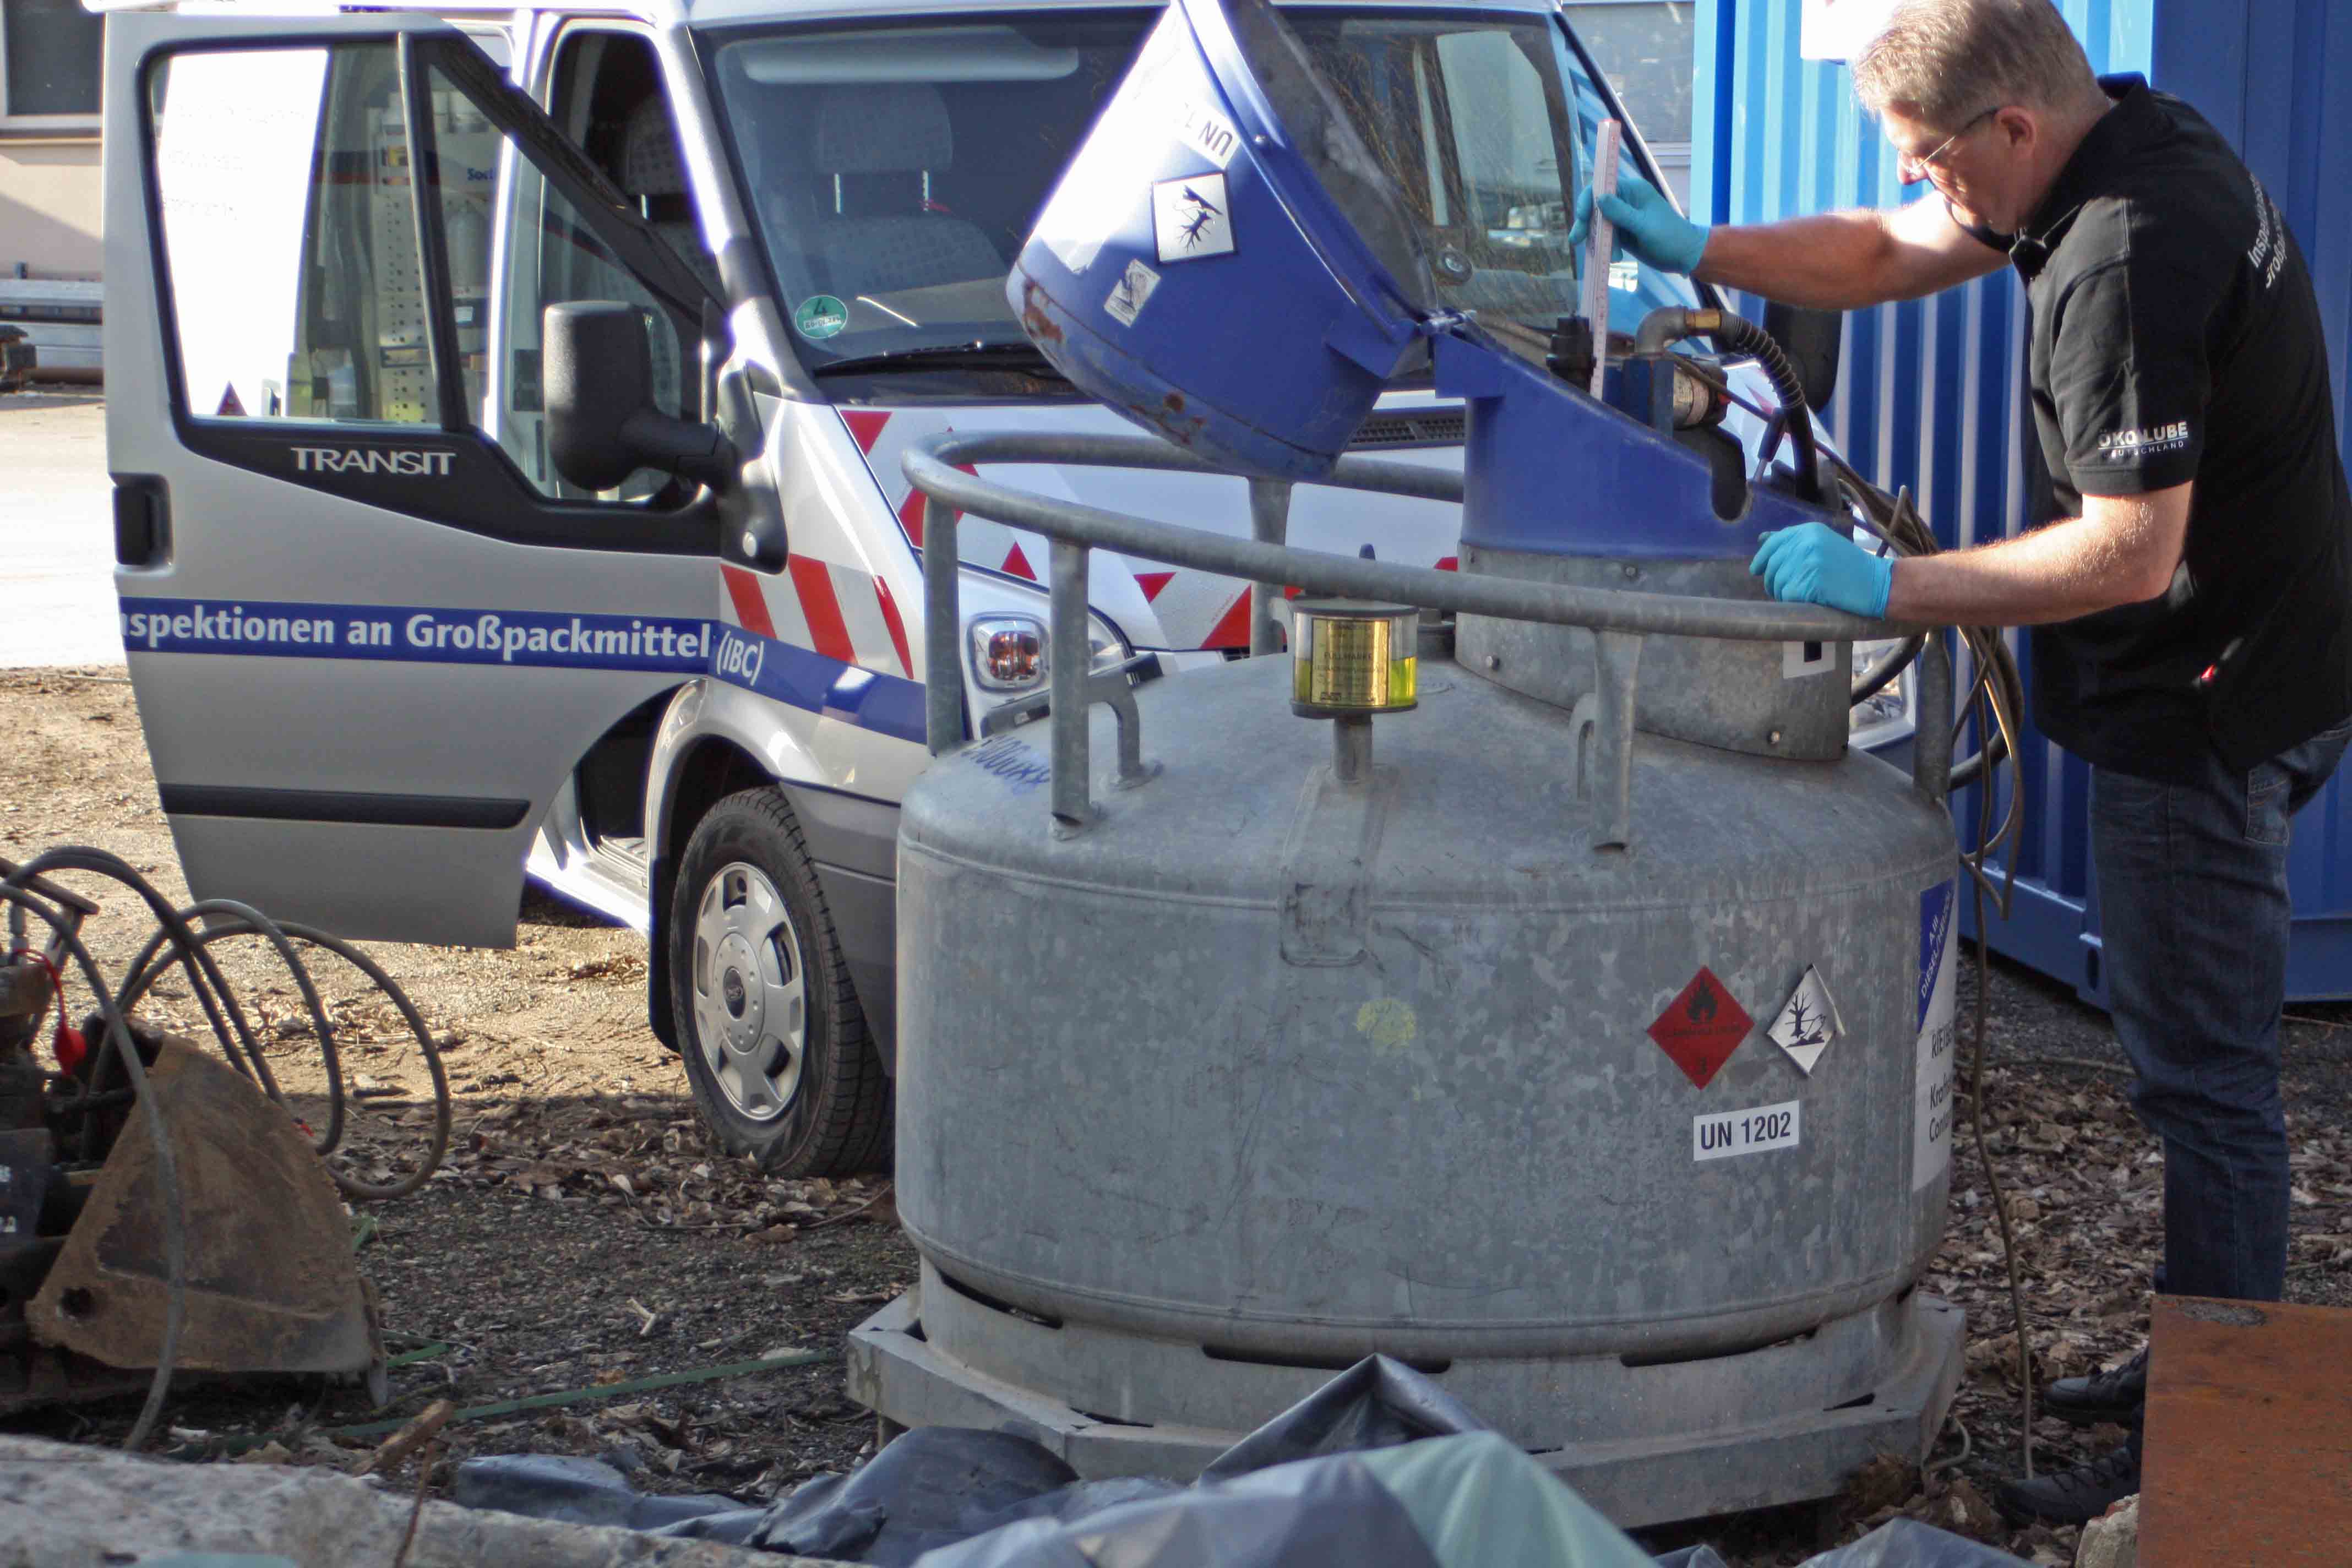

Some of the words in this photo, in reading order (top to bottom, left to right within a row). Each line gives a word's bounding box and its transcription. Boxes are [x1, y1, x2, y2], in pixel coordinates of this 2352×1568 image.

[291, 447, 456, 475] TRANSIT
[347, 620, 392, 645] an
[406, 614, 711, 661] Großpackmittel
[716, 630, 765, 686] (IBC)
[1701, 1120, 1732, 1150] UN
[1741, 1111, 1792, 1144] 1202
